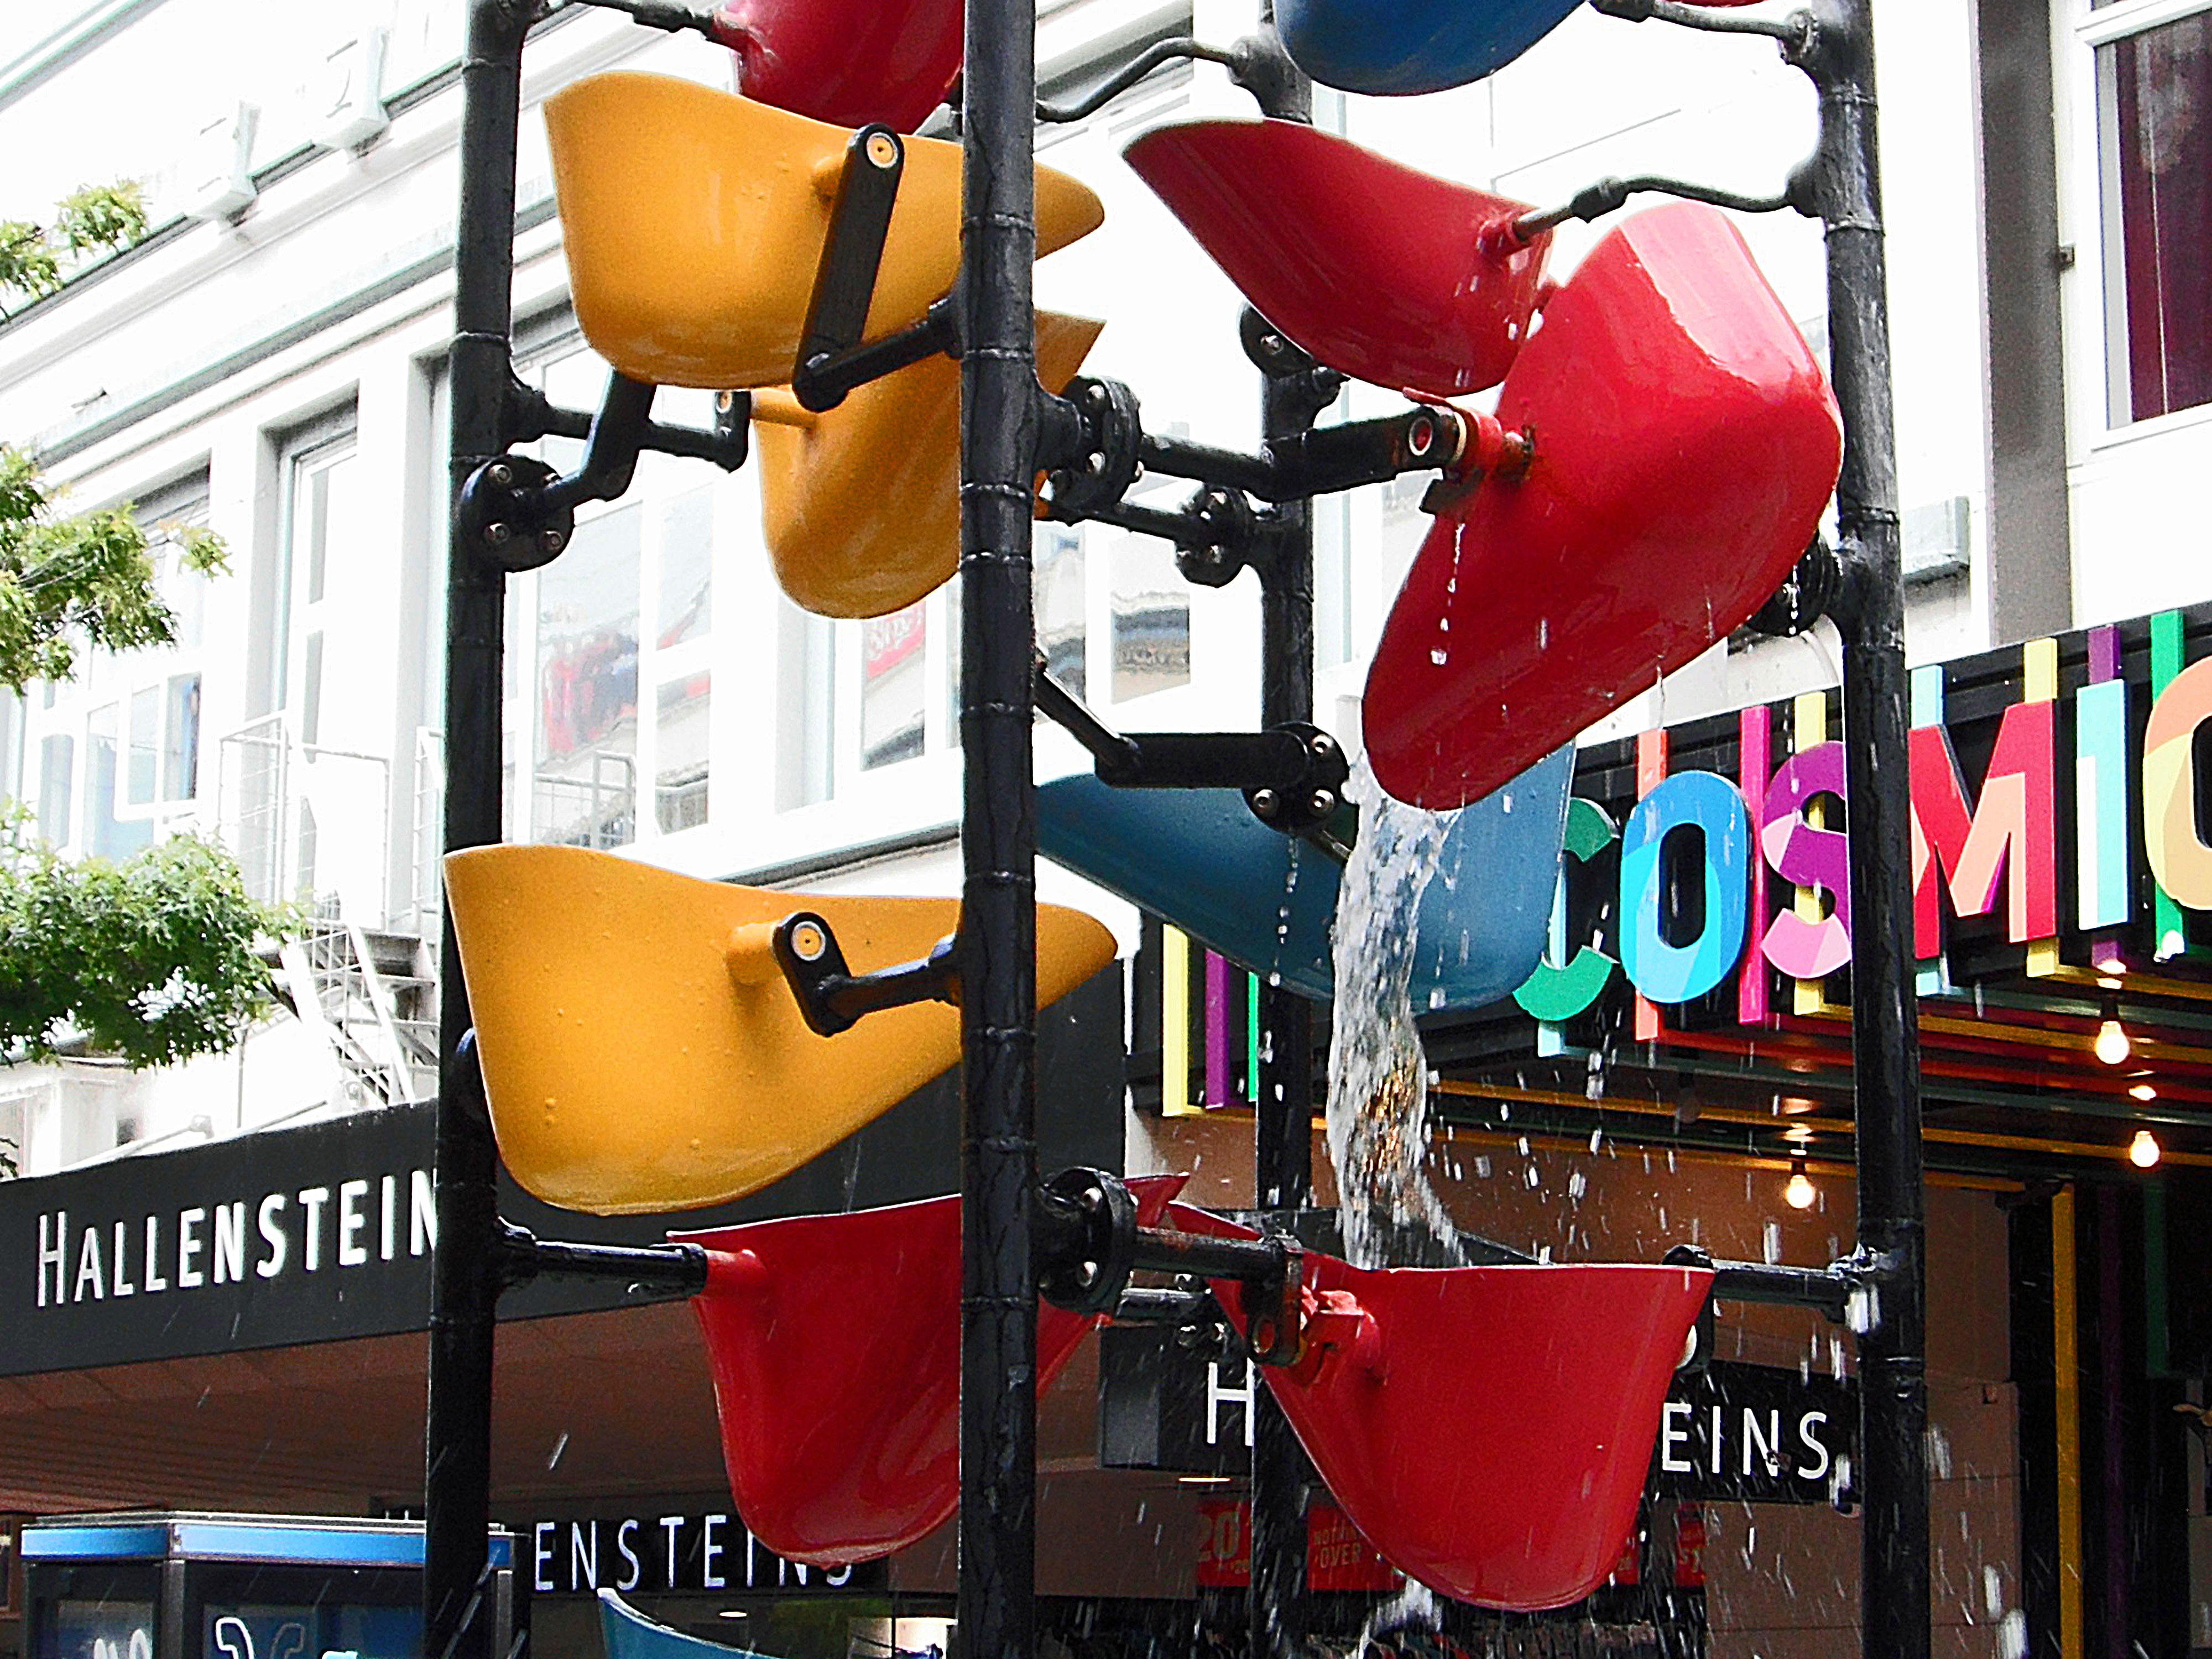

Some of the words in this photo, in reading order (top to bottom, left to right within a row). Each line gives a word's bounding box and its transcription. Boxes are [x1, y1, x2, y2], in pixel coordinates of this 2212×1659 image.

[37, 1168, 437, 1307] HALLENSTEIN
[1662, 1402, 1829, 1480] EINS
[1319, 1542, 1362, 1569] OVER
